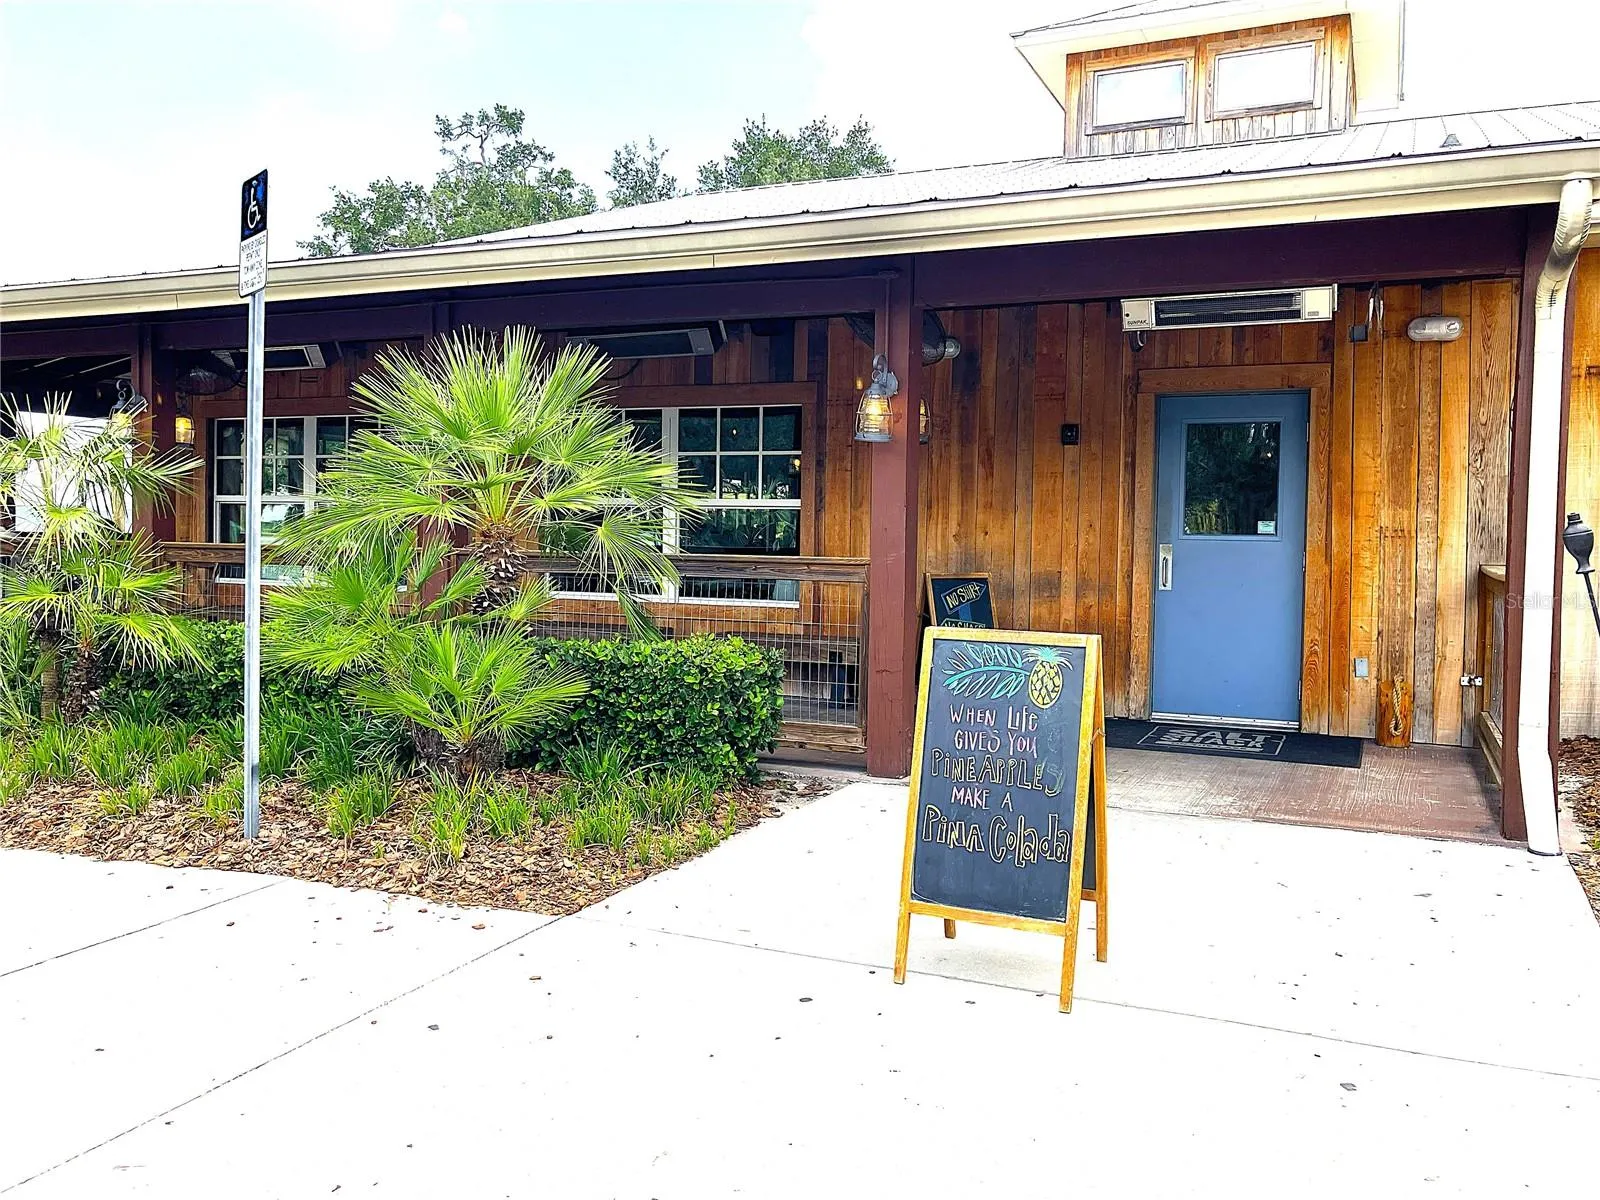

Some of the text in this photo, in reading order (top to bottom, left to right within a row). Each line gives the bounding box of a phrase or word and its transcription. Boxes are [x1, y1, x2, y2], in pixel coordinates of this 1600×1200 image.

[946, 592, 959, 608] NO
[950, 703, 996, 727] WHEN
[954, 729, 1038, 759] GIVES YOU
[1159, 736, 1265, 748] SHACK
[1166, 729, 1271, 743] SALT
[951, 786, 1013, 812] MAKE A
[989, 814, 1071, 868] Colada
